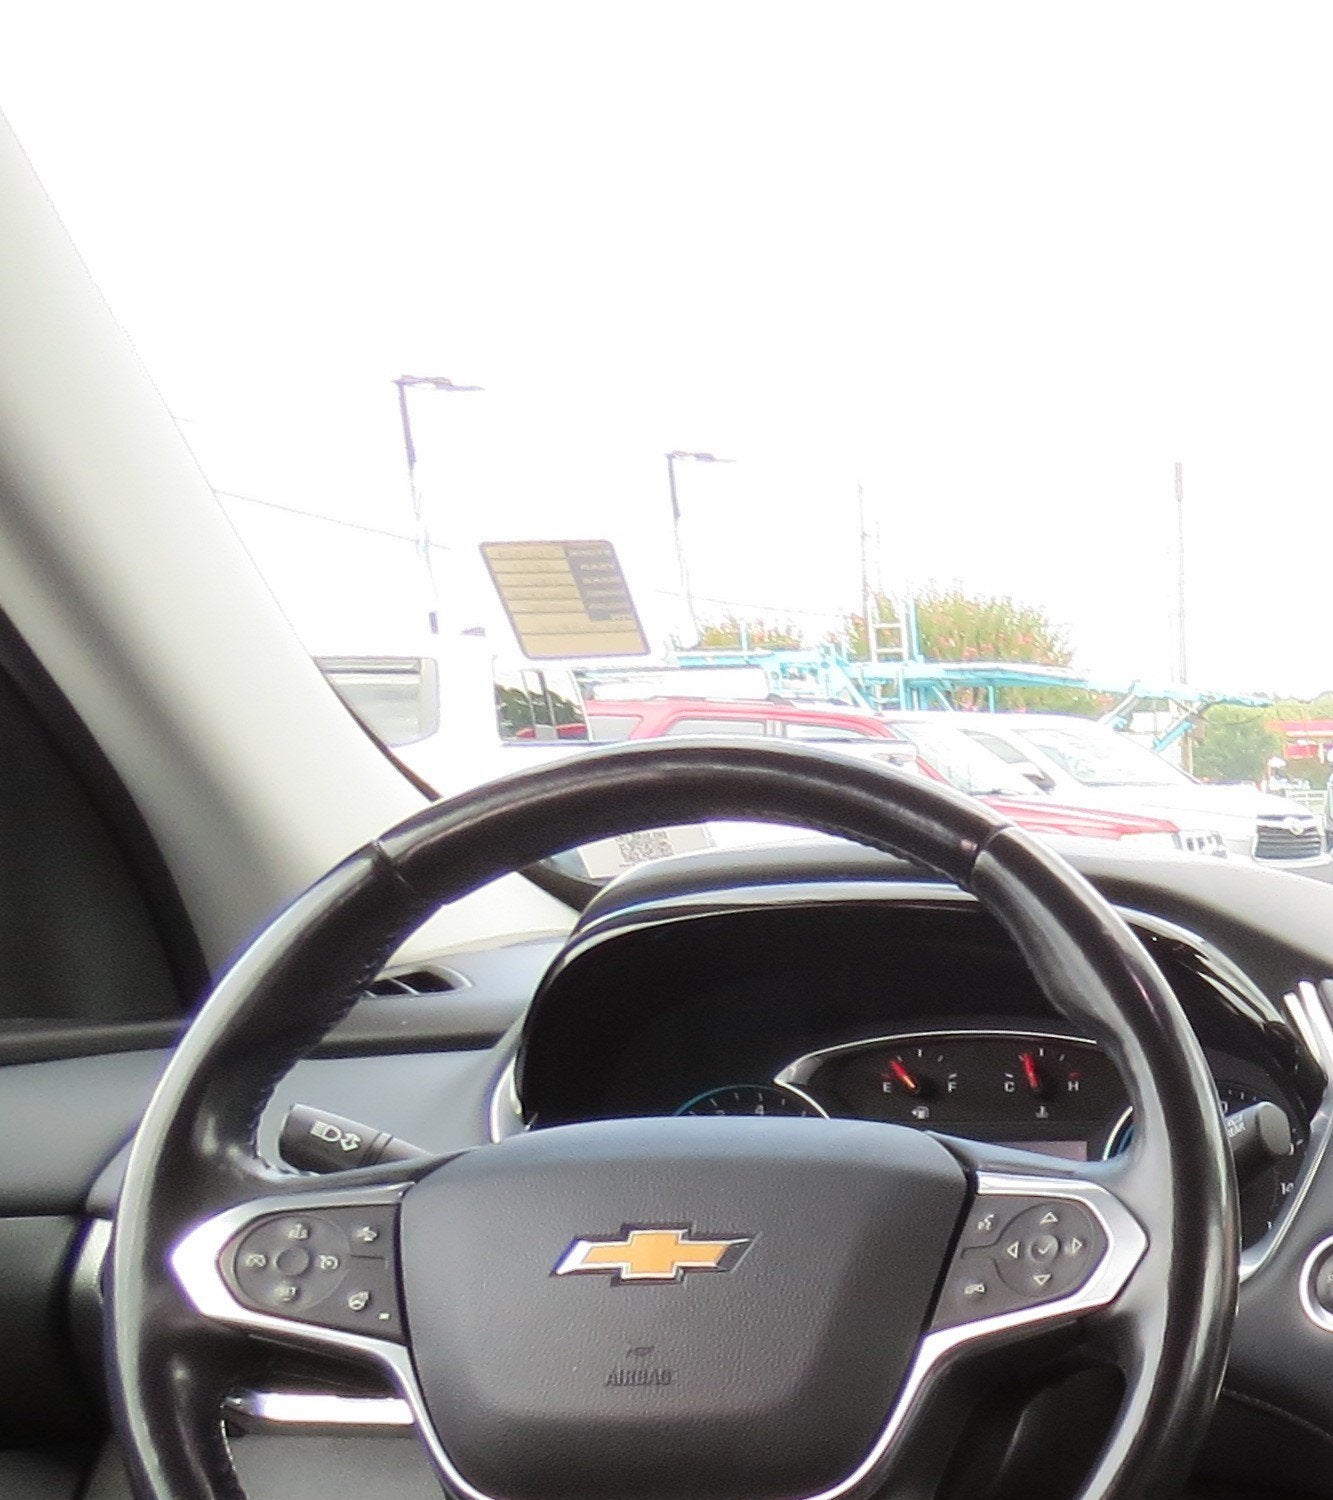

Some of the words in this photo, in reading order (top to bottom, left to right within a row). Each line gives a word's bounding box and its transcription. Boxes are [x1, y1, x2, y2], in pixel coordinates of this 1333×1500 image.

[882, 1081, 892, 1093] E
[947, 1081, 958, 1092] F
[1004, 1080, 1015, 1092] C
[1067, 1080, 1080, 1091] H
